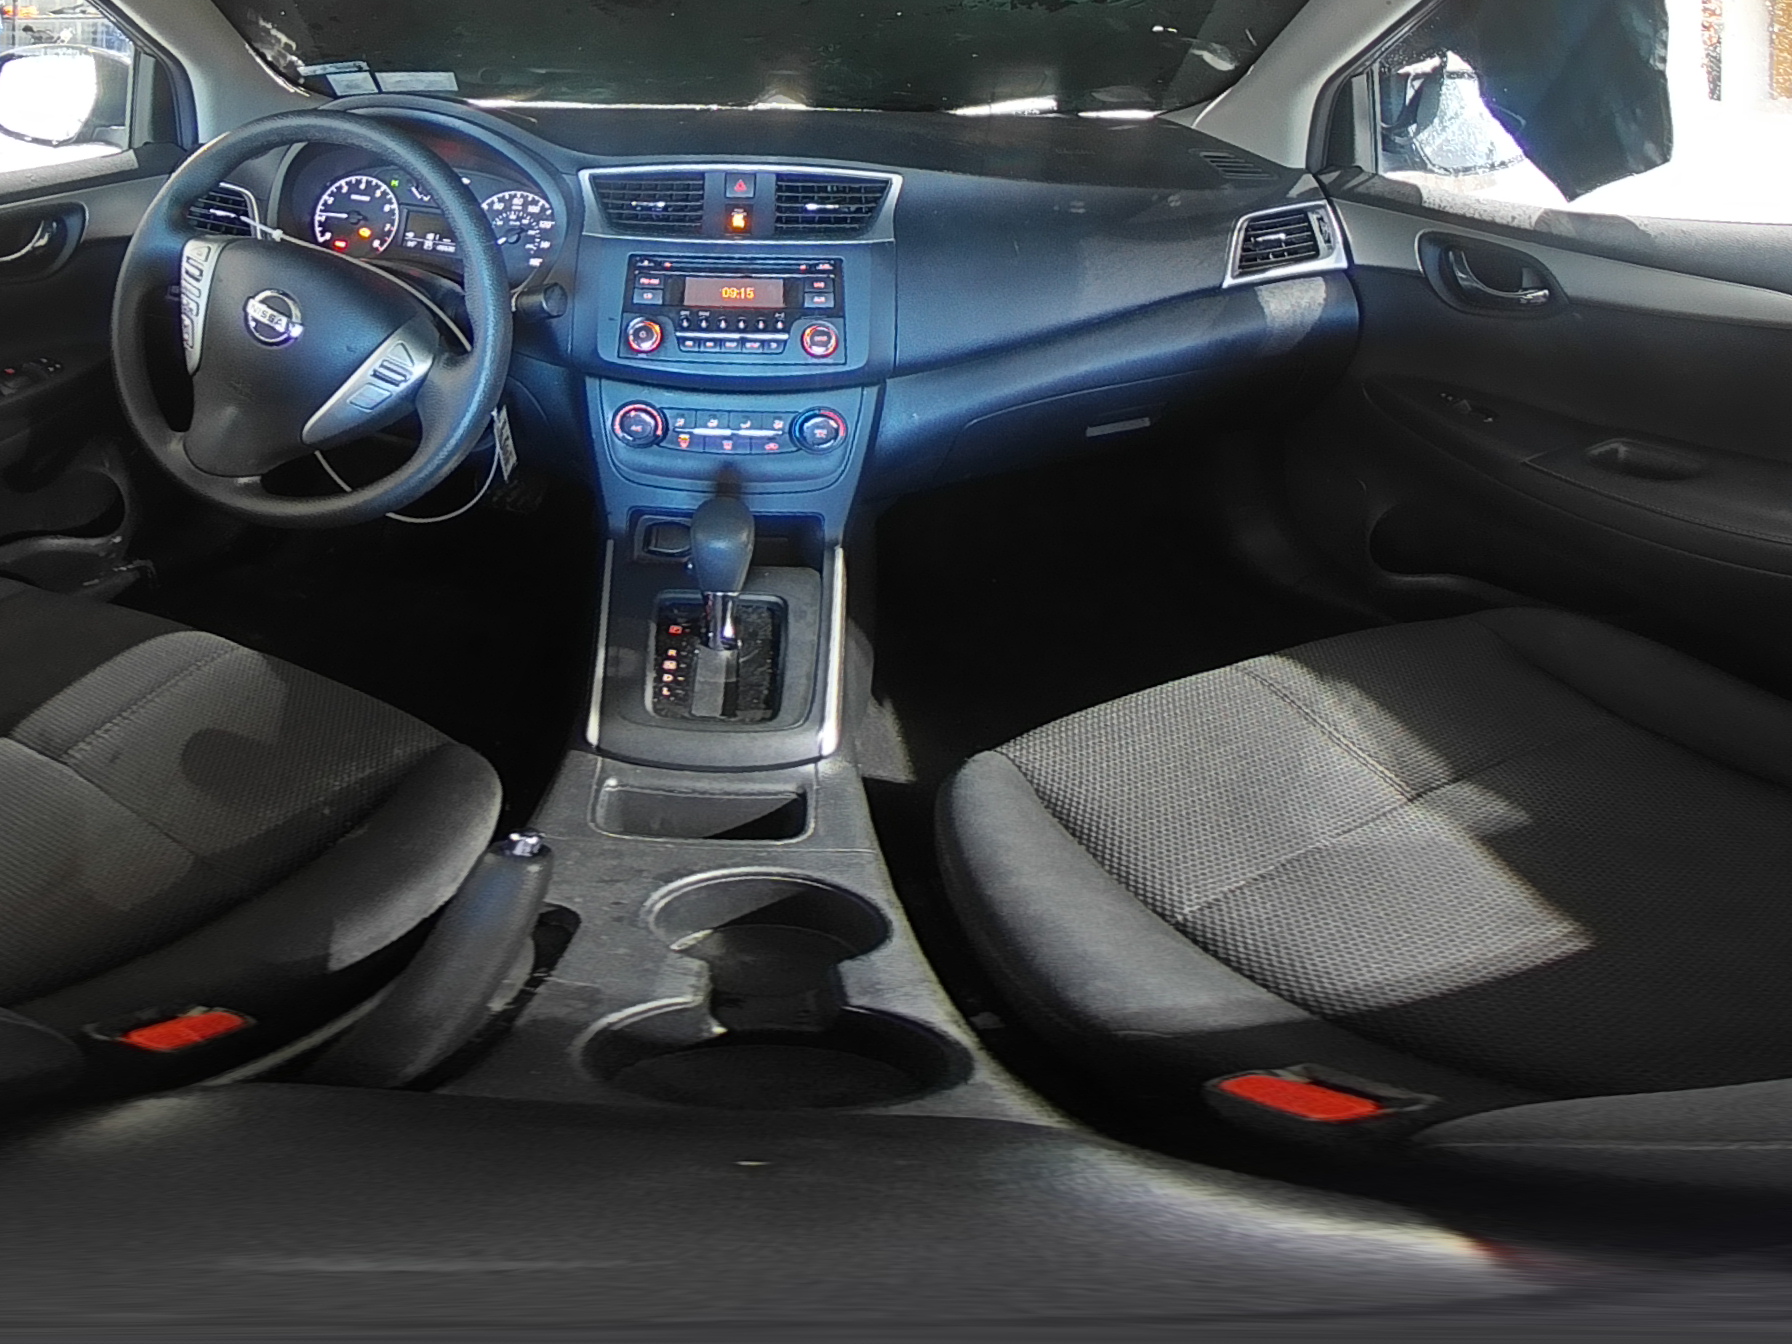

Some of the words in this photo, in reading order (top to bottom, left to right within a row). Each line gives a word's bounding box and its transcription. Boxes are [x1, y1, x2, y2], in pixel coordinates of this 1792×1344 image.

[721, 286, 755, 299] 09:15
[249, 301, 288, 332] NISSA
[662, 673, 674, 682] D
